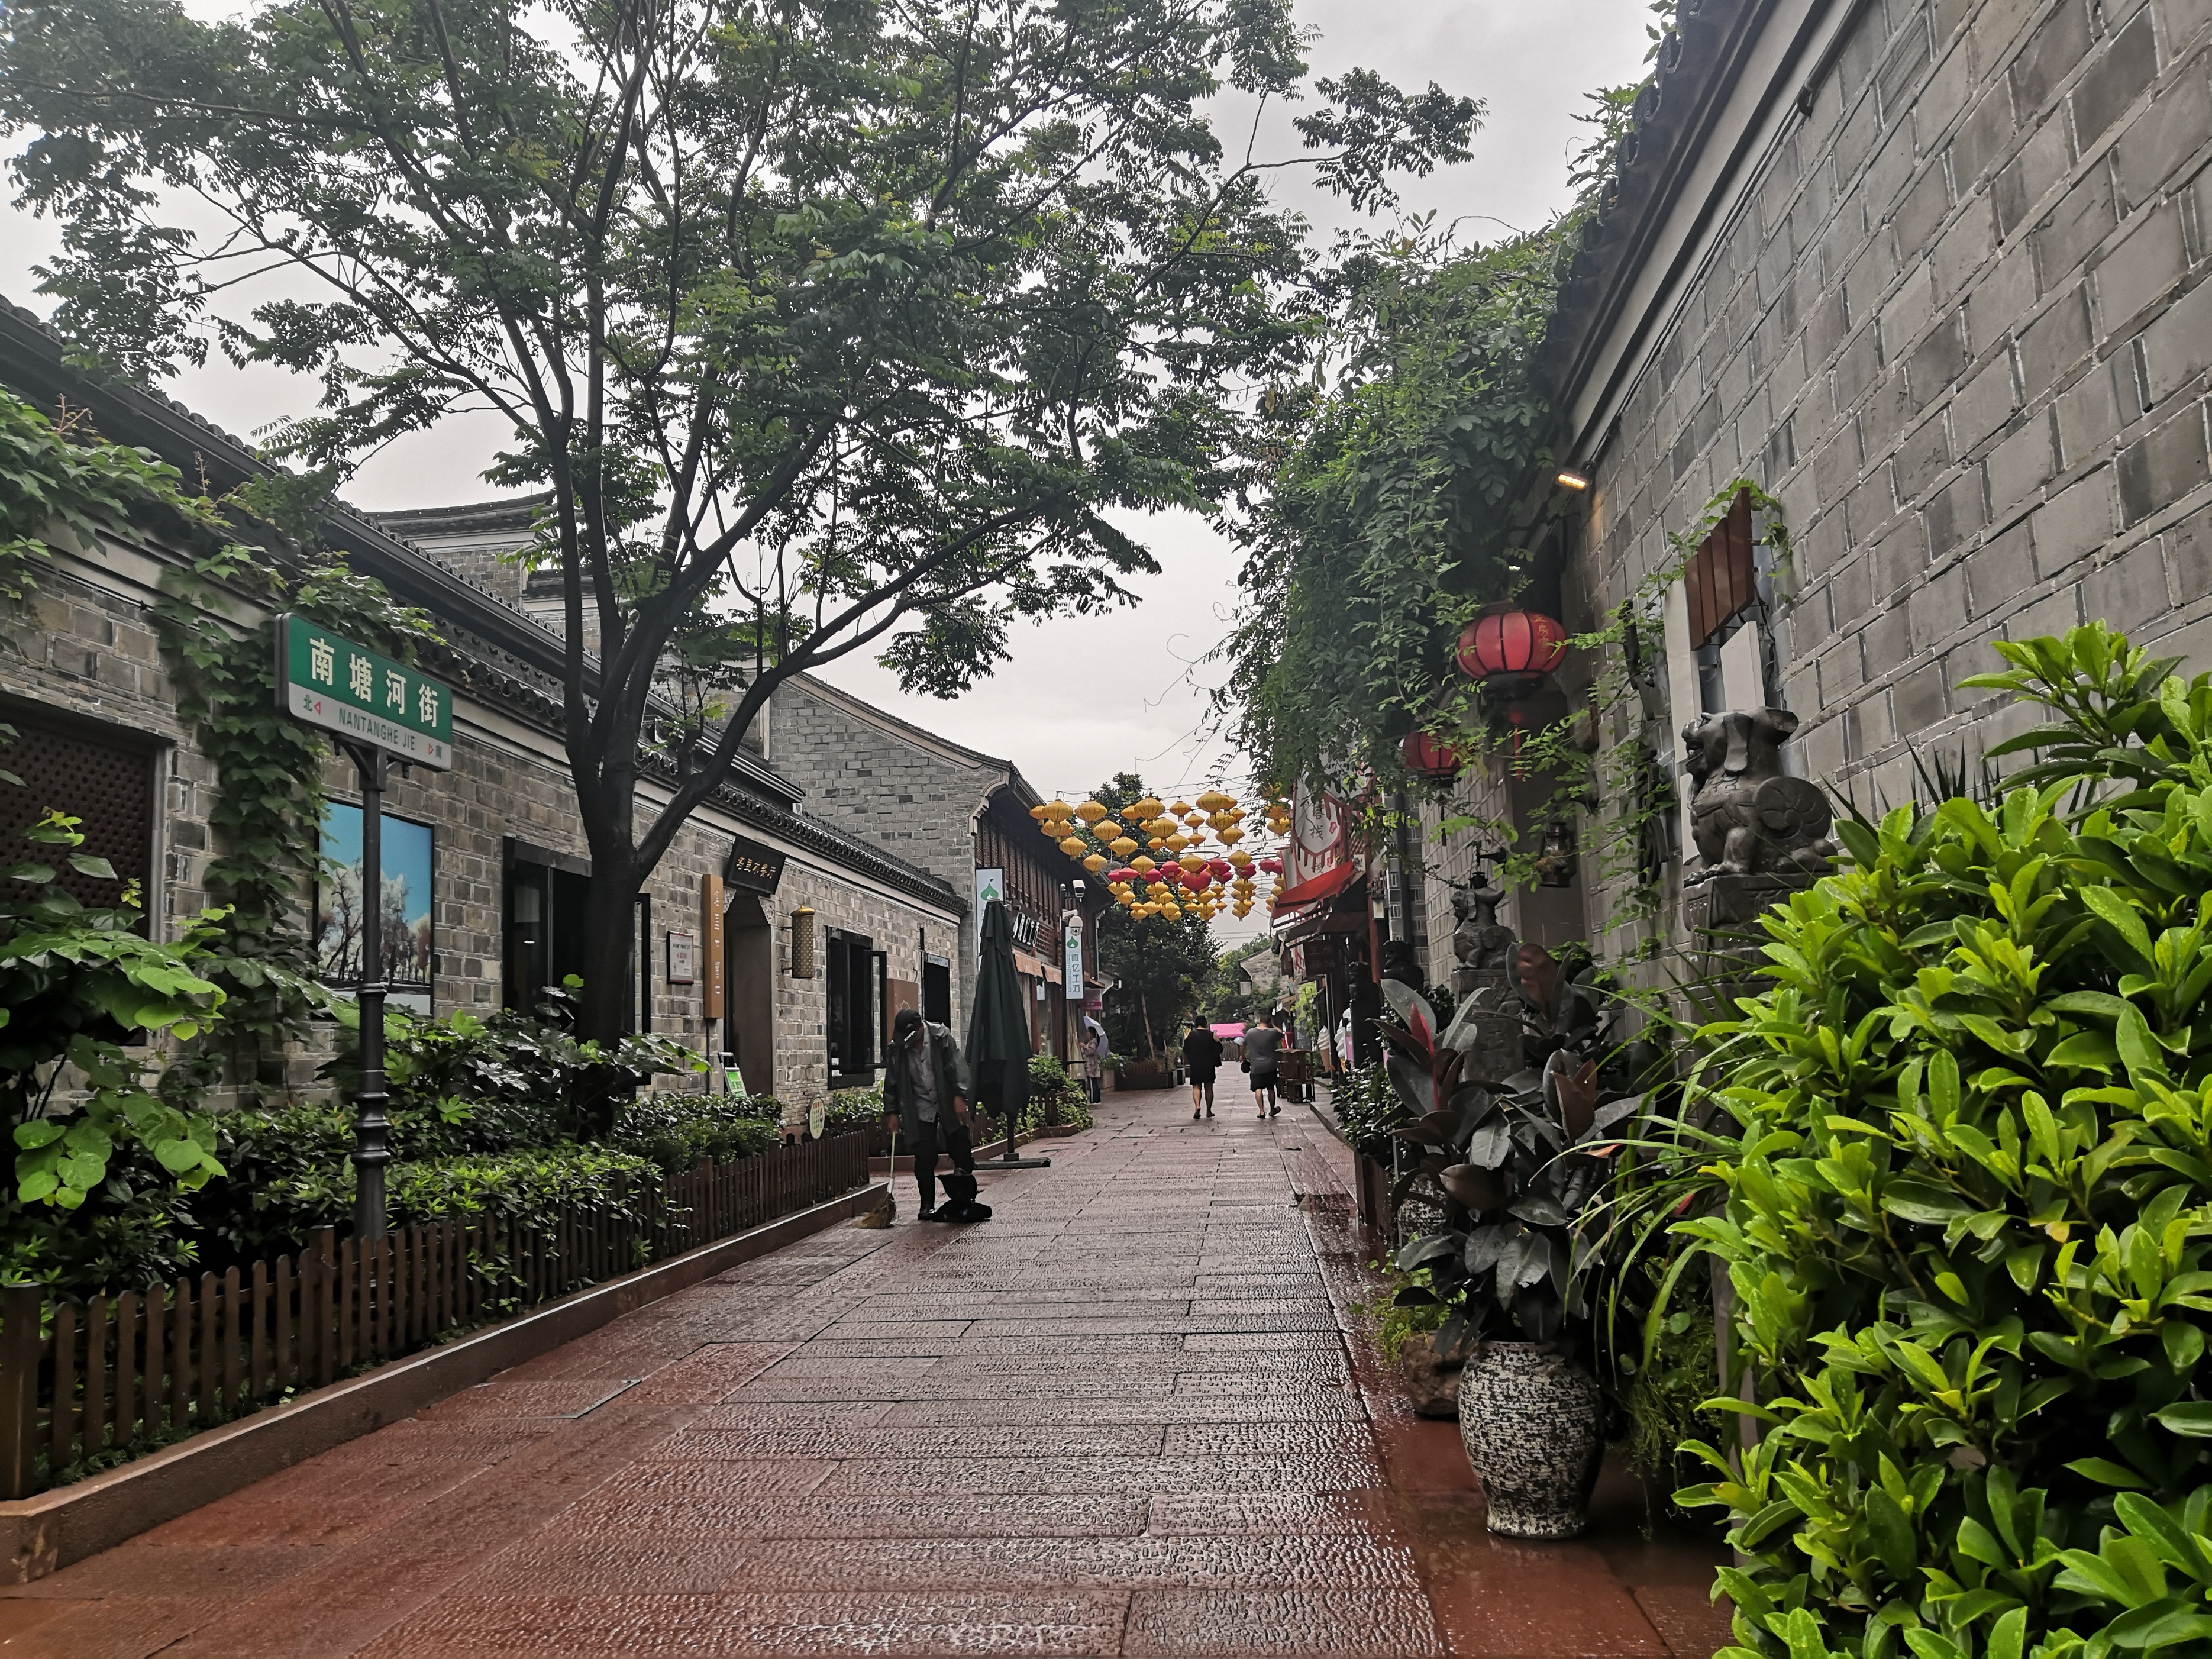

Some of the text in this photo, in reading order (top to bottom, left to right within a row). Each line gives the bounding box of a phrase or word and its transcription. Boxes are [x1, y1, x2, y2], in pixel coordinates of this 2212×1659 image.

[309, 637, 438, 728] 南塘河街
[303, 694, 313, 712] 北
[338, 708, 415, 751] NANTANGHE JIE
[435, 745, 443, 759] 南
